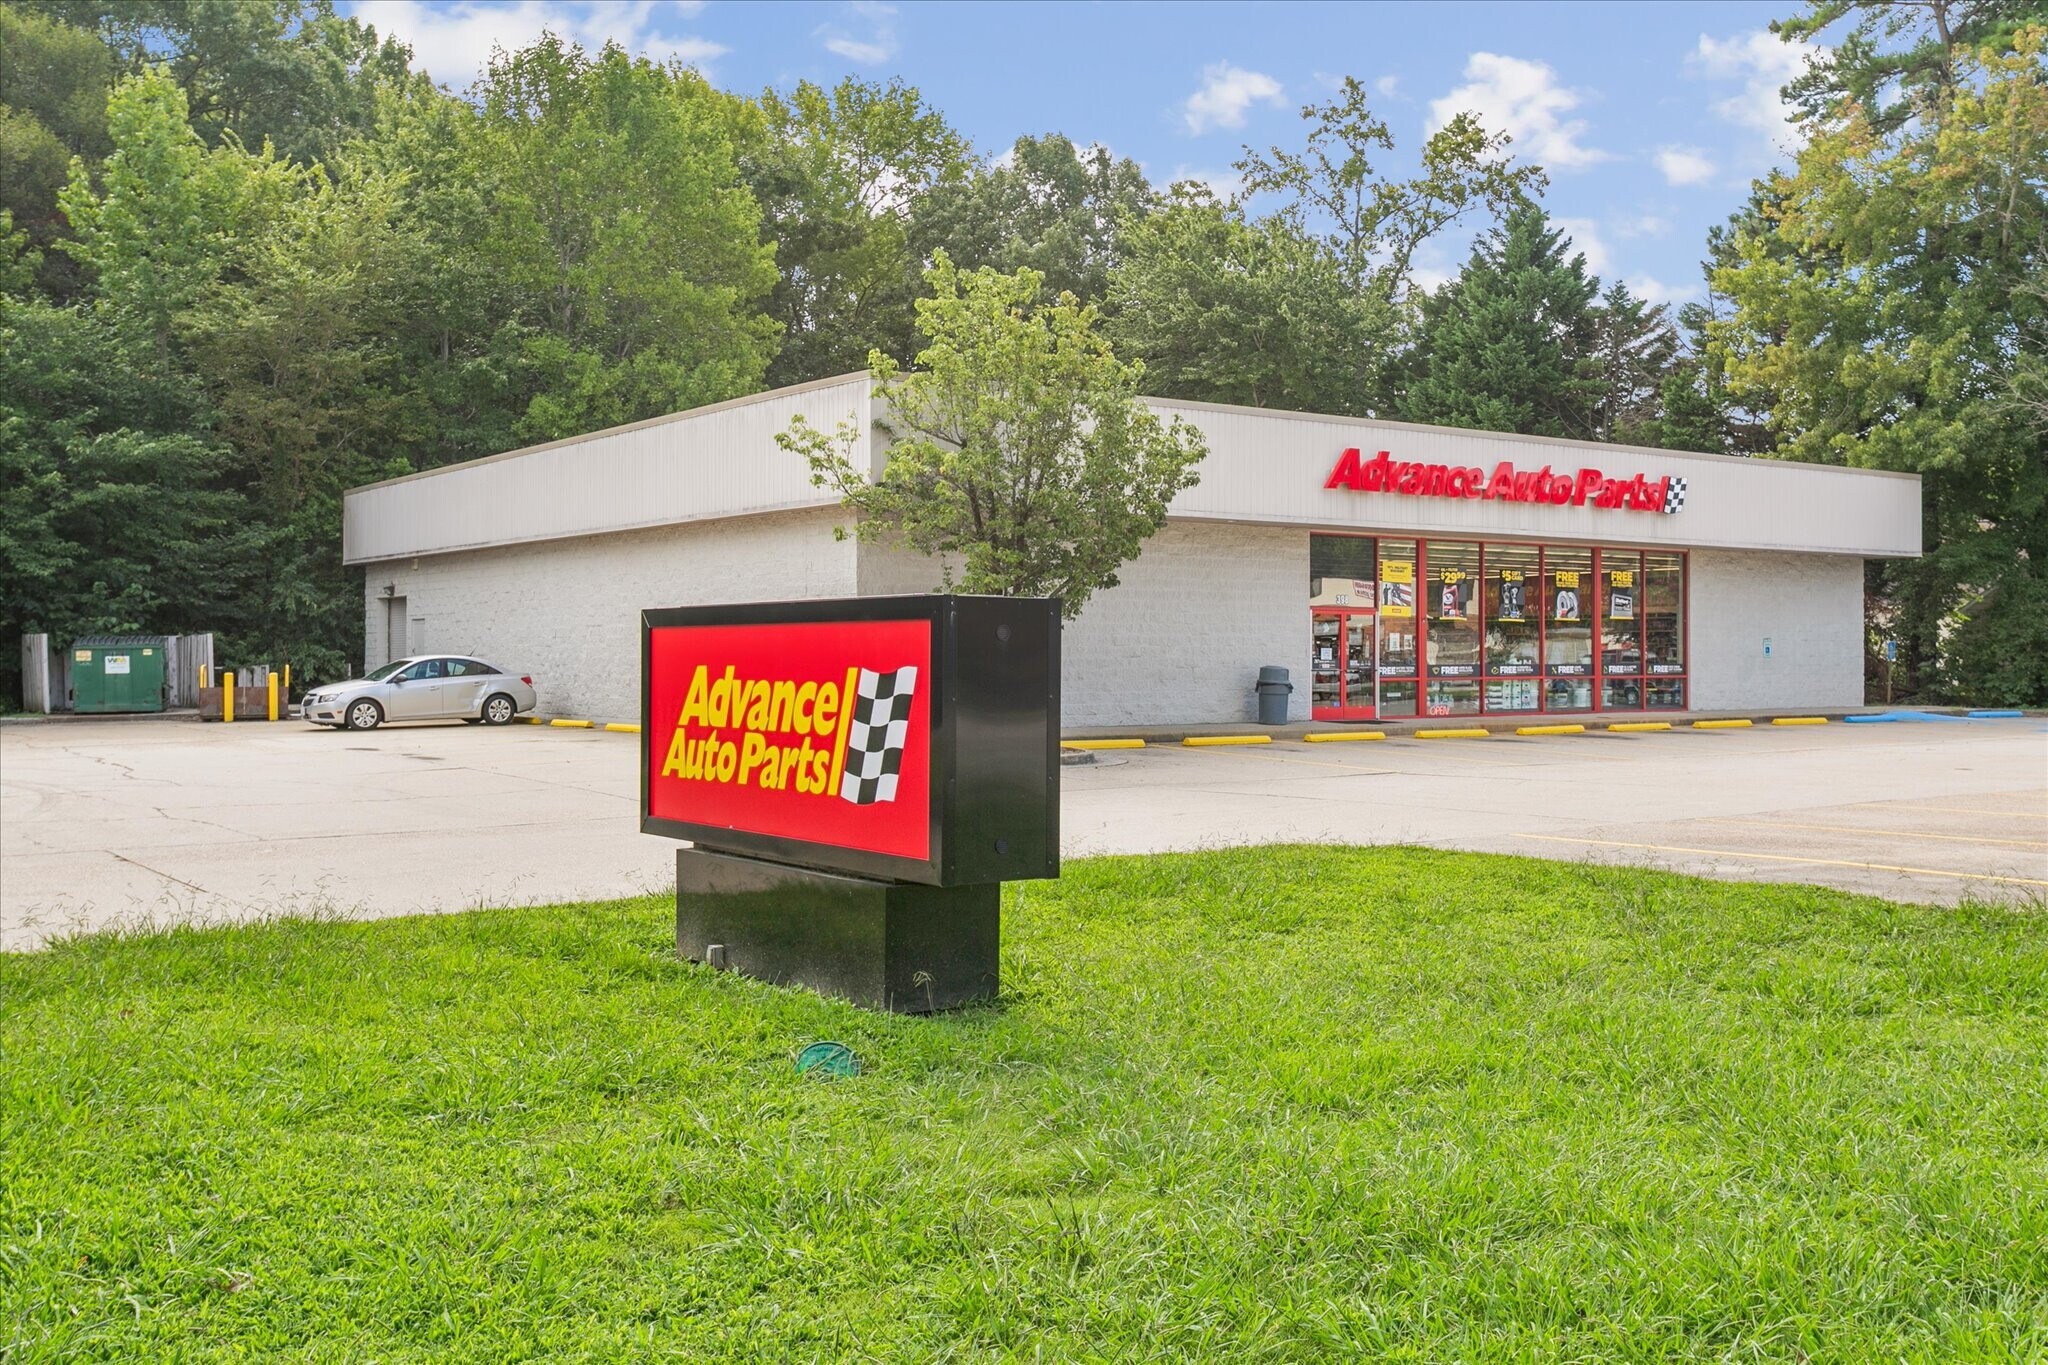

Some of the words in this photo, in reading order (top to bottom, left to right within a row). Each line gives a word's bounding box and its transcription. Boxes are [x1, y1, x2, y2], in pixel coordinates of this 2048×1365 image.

[1323, 447, 1484, 499] Advance
[1482, 461, 1574, 506] Auto
[1571, 468, 1663, 513] Parts
[1501, 570, 1512, 582] $5
[1556, 570, 1580, 582] FREE
[1611, 570, 1634, 582] FREE
[1379, 666, 1397, 675] FREE
[1441, 666, 1459, 675] FREE
[1500, 665, 1517, 674] FREE
[1558, 665, 1575, 674] FREE
[1608, 665, 1624, 673] FREE
[1653, 665, 1669, 673] FREE
[678, 664, 839, 737] Advance
[1430, 705, 1450, 716] OPEN
[661, 727, 738, 784] Auto
[737, 731, 831, 796] Parts
